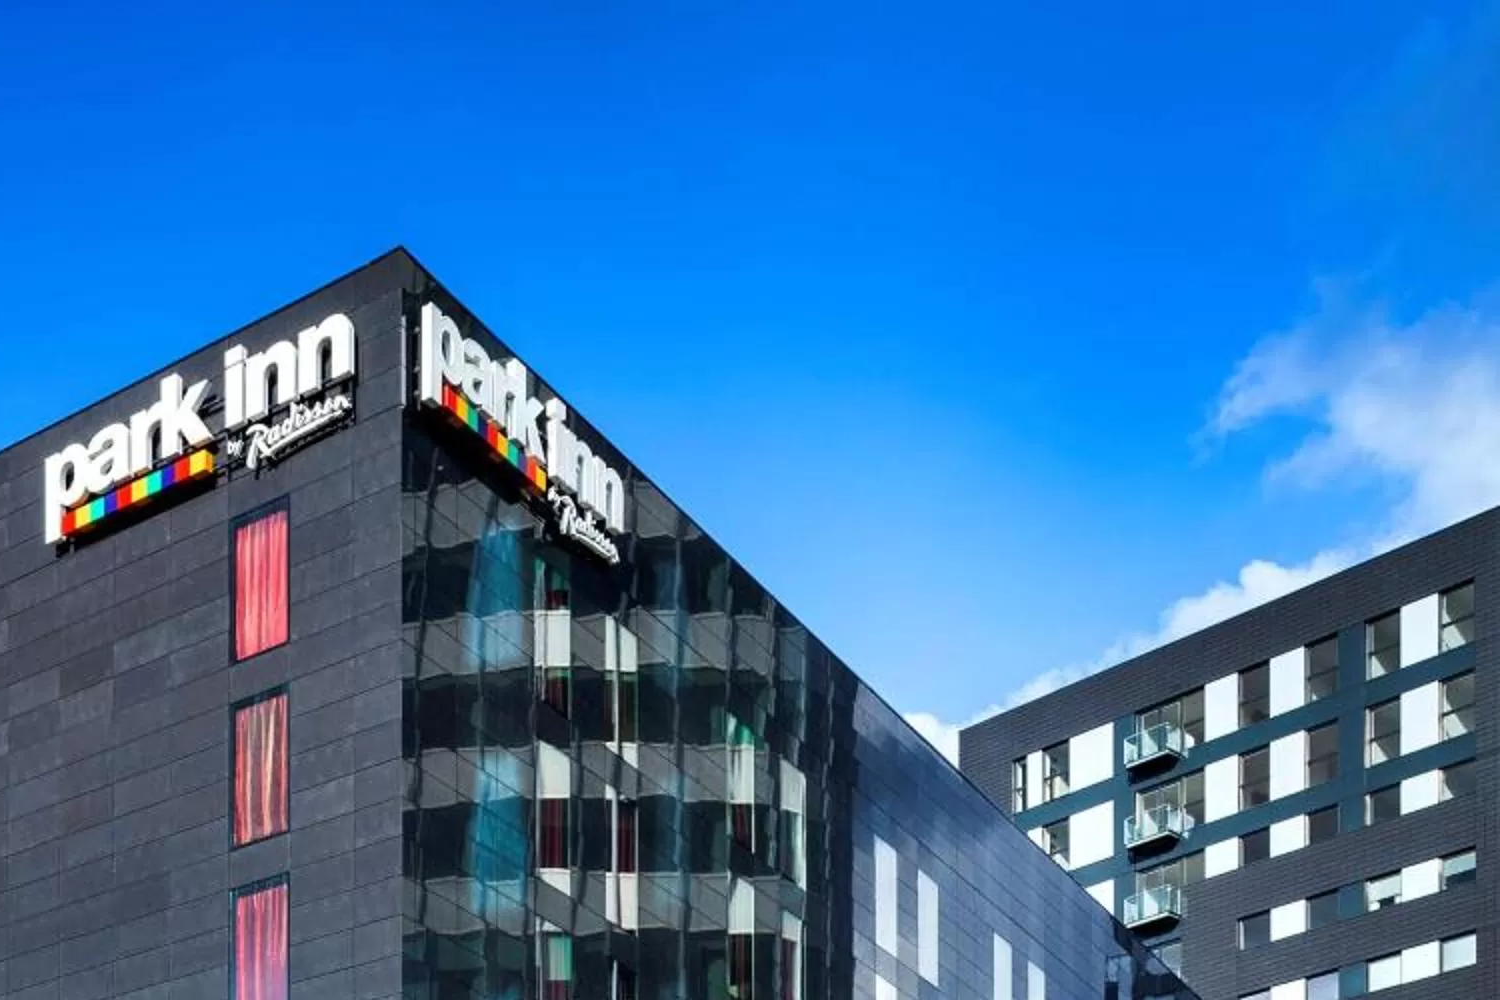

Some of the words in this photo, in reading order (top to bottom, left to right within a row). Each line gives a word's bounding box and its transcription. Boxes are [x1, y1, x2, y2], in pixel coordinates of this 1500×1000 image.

[44, 372, 213, 545] park
[224, 312, 356, 428] inn
[227, 439, 244, 458] by
[245, 395, 352, 470] Radisson
[421, 301, 548, 462] park
[546, 398, 624, 534] inn
[559, 495, 620, 565] Radisson
